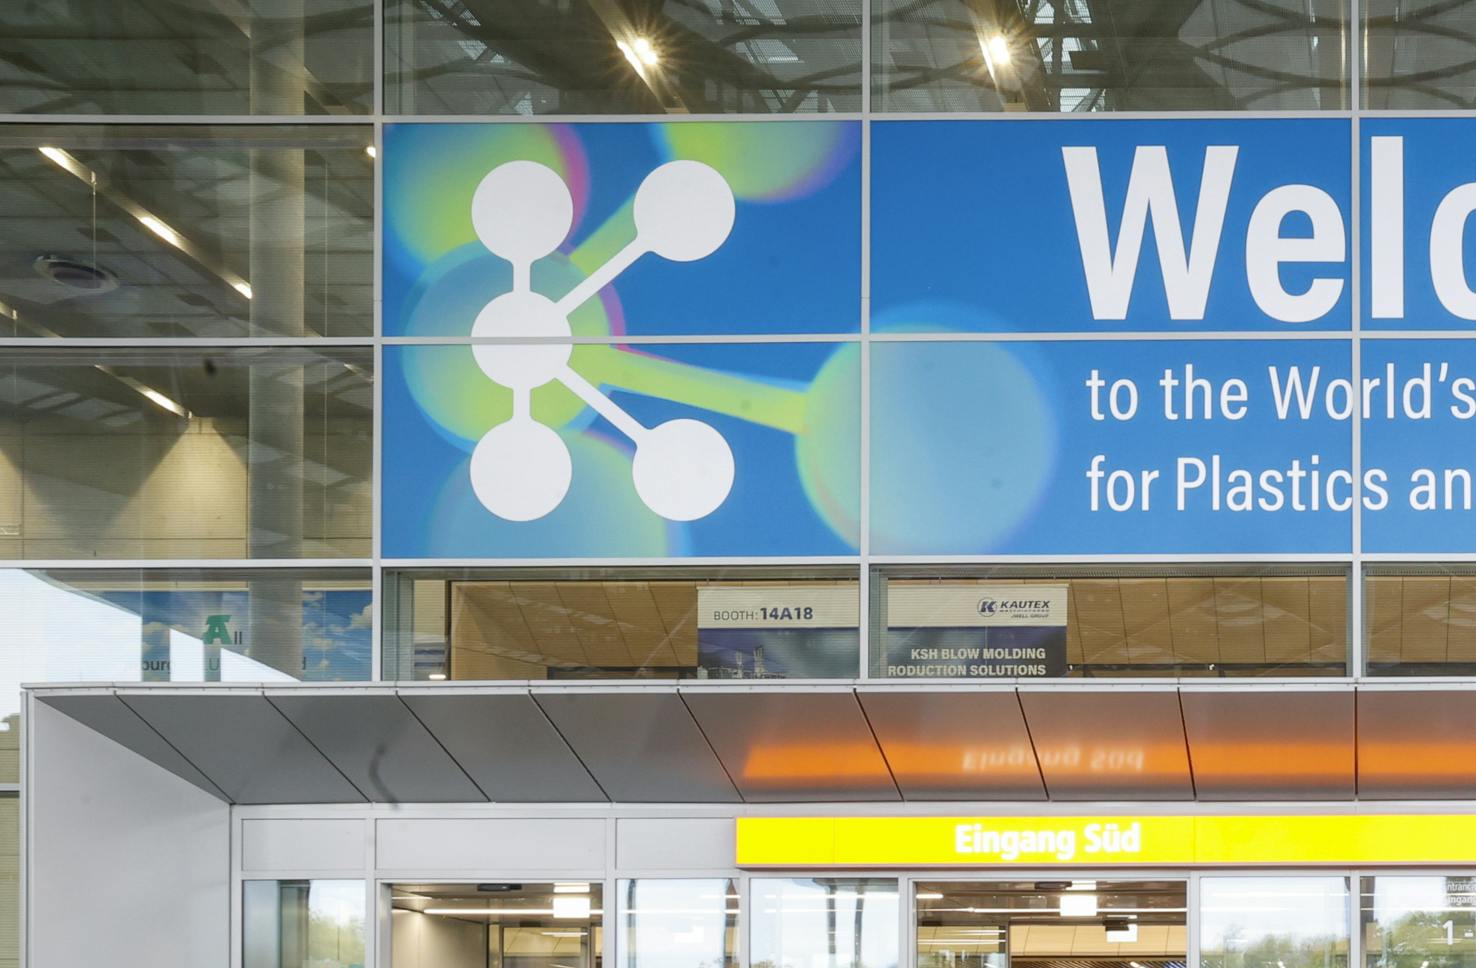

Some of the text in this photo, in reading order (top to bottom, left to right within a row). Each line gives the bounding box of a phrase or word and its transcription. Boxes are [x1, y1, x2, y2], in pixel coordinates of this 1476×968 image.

[1086, 370, 1138, 420] to
[1159, 364, 1248, 420] the
[1269, 363, 1476, 420] World's
[1086, 455, 1159, 512] for
[1177, 454, 1389, 512] Plastics
[713, 607, 814, 621] BOOTH: 14A18
[1000, 600, 1050, 609] KAUTEX
[911, 648, 1046, 660] KSH BLOW MOLDING
[888, 664, 1046, 676] RODUCTION SOLUTIONS
[955, 822, 1142, 860] Eingang Süd
[1442, 920, 1453, 945] 1
